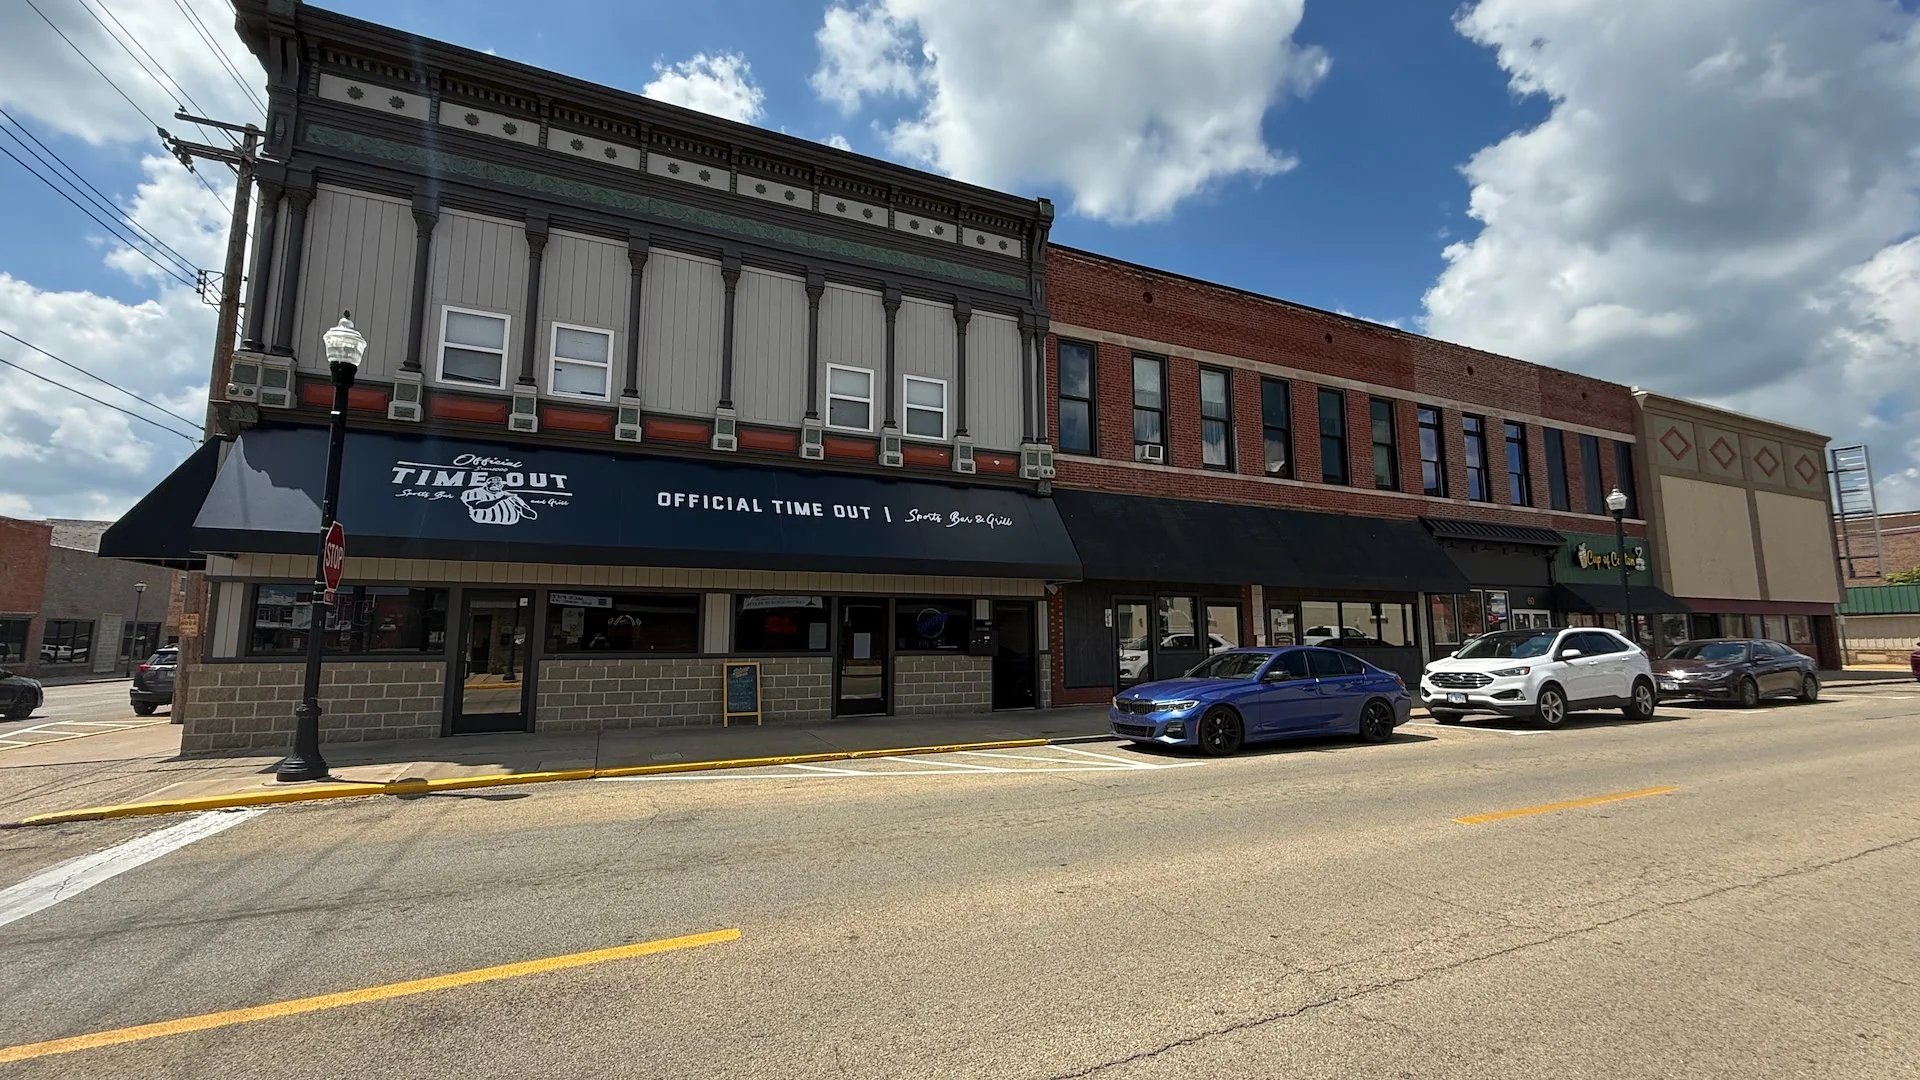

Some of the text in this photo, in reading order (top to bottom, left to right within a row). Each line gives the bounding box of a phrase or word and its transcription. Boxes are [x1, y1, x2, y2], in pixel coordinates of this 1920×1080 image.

[453, 453, 523, 468] Official
[391, 466, 567, 489] TIME OUT
[657, 491, 763, 513] OFFICIAL
[771, 500, 824, 517] TIME
[833, 504, 871, 520] OUT
[905, 508, 943, 523] Sports
[946, 511, 973, 527] Bar
[975, 514, 985, 524] &
[986, 513, 1013, 529] Grill
[325, 542, 344, 570] STOP
